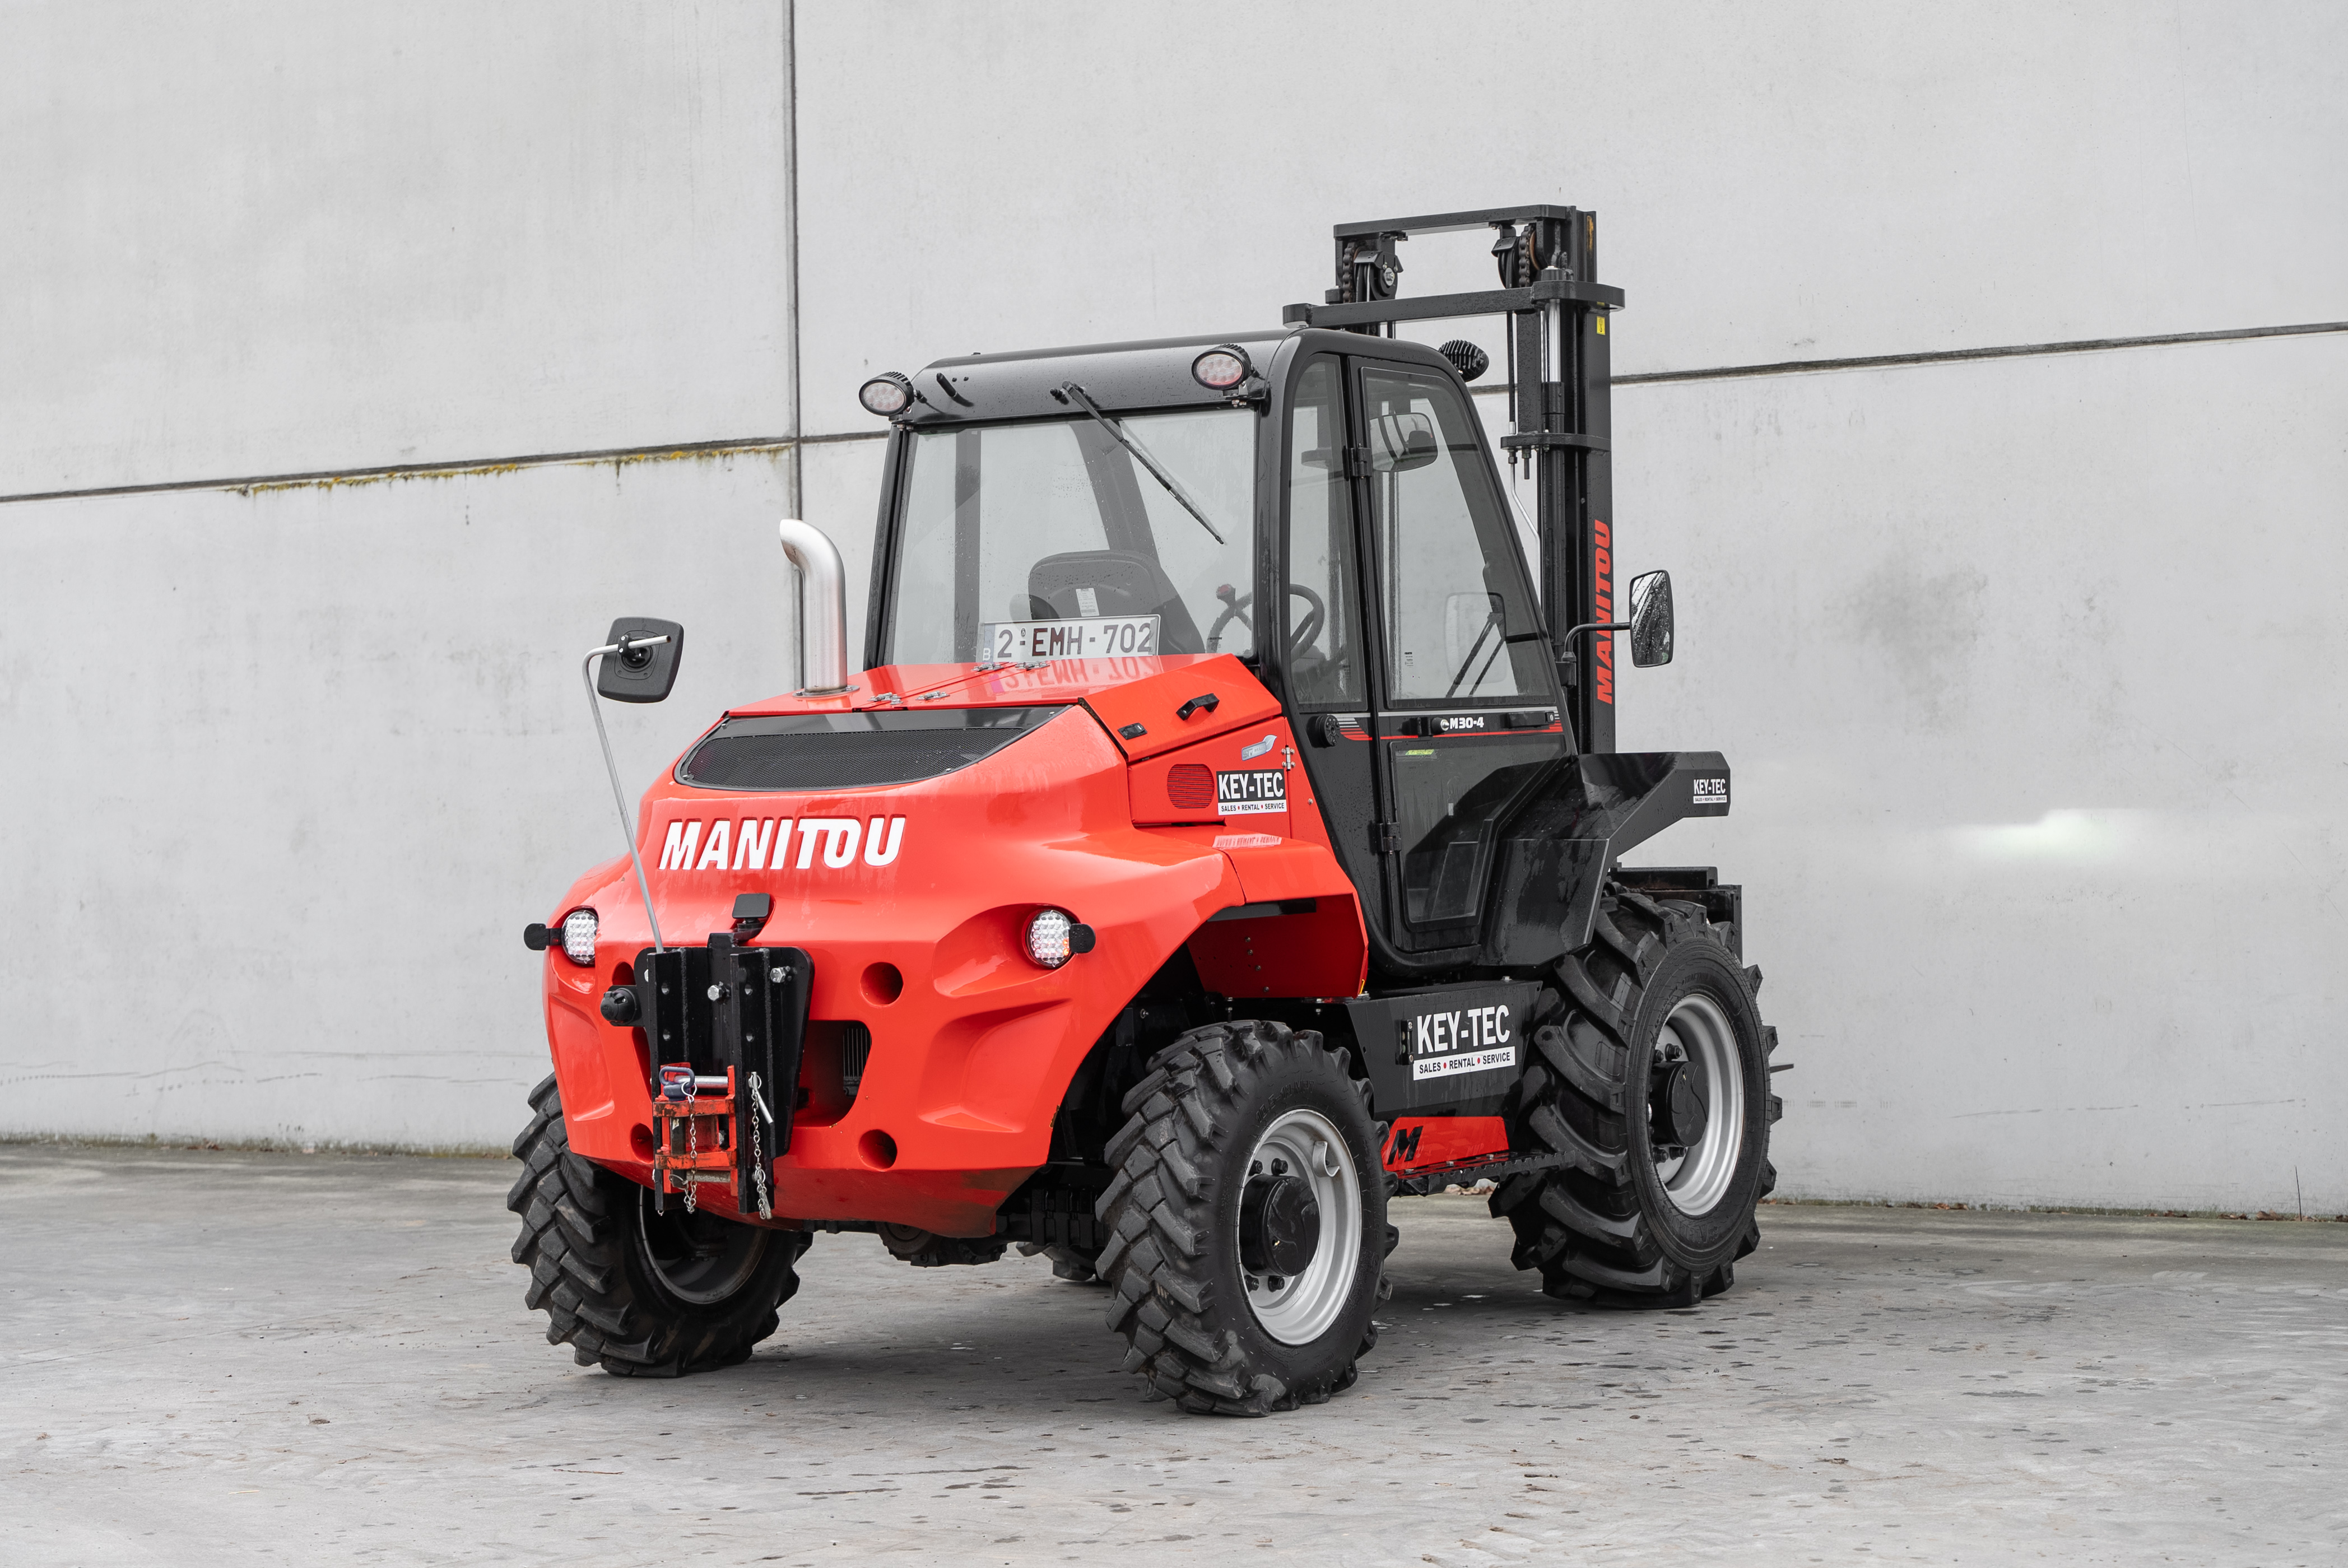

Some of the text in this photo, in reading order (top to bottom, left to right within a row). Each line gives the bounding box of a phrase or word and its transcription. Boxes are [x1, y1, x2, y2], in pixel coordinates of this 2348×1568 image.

[1594, 520, 1612, 704] MANITOU
[982, 648, 991, 661] B
[1449, 716, 1484, 729] M30-4
[1218, 772, 1284, 799] KEY-TEC
[1694, 779, 1726, 794] KEY-TEC
[659, 817, 906, 871] MANITOU
[1416, 1004, 1510, 1054] KEY-TEC
[1419, 1051, 1511, 1074] SALES RENTAL SERVICE
